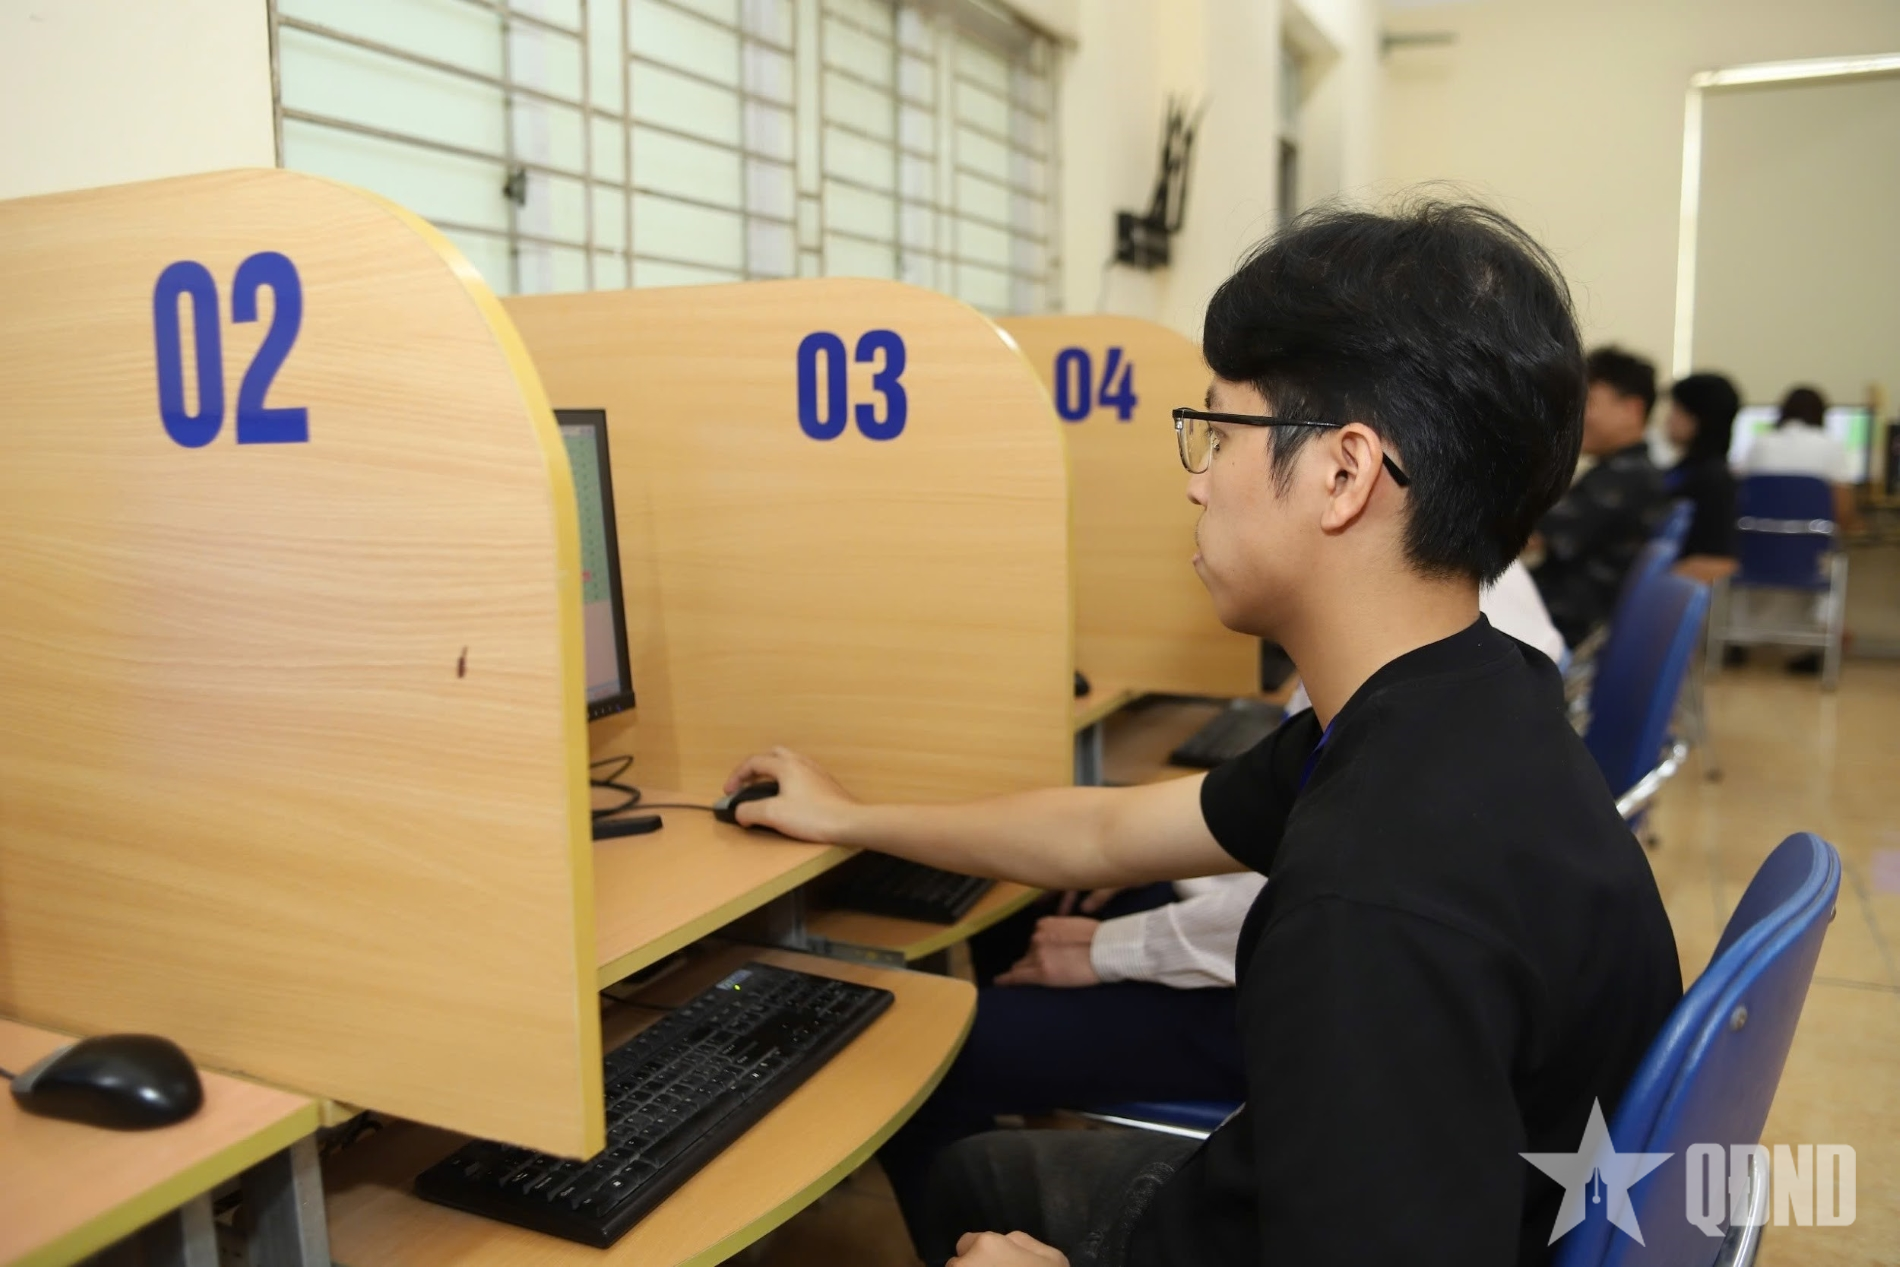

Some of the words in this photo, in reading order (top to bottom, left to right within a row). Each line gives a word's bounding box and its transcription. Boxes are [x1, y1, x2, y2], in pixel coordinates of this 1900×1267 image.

[153, 251, 310, 449] 02
[797, 329, 908, 441] 03
[1055, 346, 1138, 422] 04
